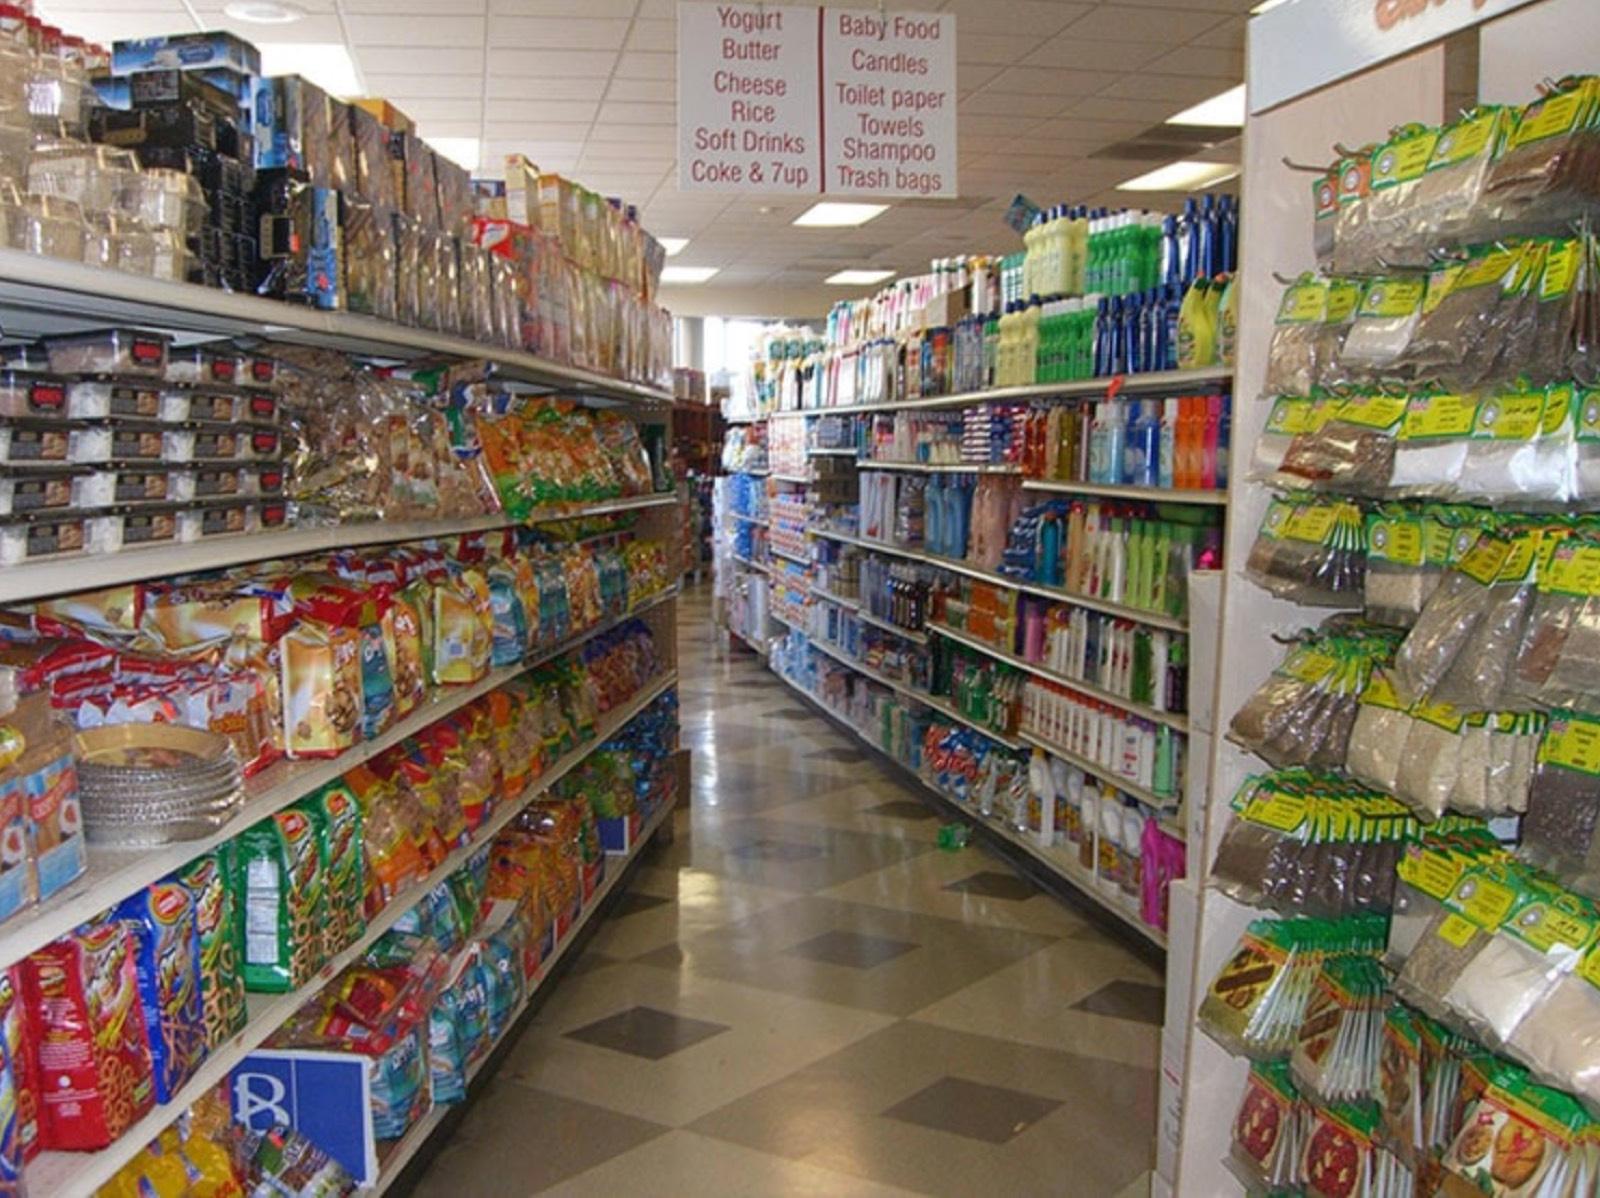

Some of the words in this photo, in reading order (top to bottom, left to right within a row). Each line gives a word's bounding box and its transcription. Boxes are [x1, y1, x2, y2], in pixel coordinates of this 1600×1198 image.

[718, 6, 782, 32] Yogurt
[840, 15, 887, 40] Baby
[895, 17, 940, 39] Food
[723, 39, 781, 60] Butter
[852, 49, 928, 75] Candles
[714, 71, 786, 96] Cheese
[836, 83, 885, 106] Toilet
[892, 90, 946, 110] paper
[732, 101, 775, 122] Rice
[858, 113, 924, 137] Towels
[696, 127, 735, 151] Soft
[744, 131, 804, 154] Drinks
[844, 138, 936, 164] Shampoo
[692, 160, 742, 182] Coke
[750, 162, 763, 182] &
[772, 162, 808, 188] 7up
[837, 165, 888, 188] Trash
[896, 166, 942, 194] bags
